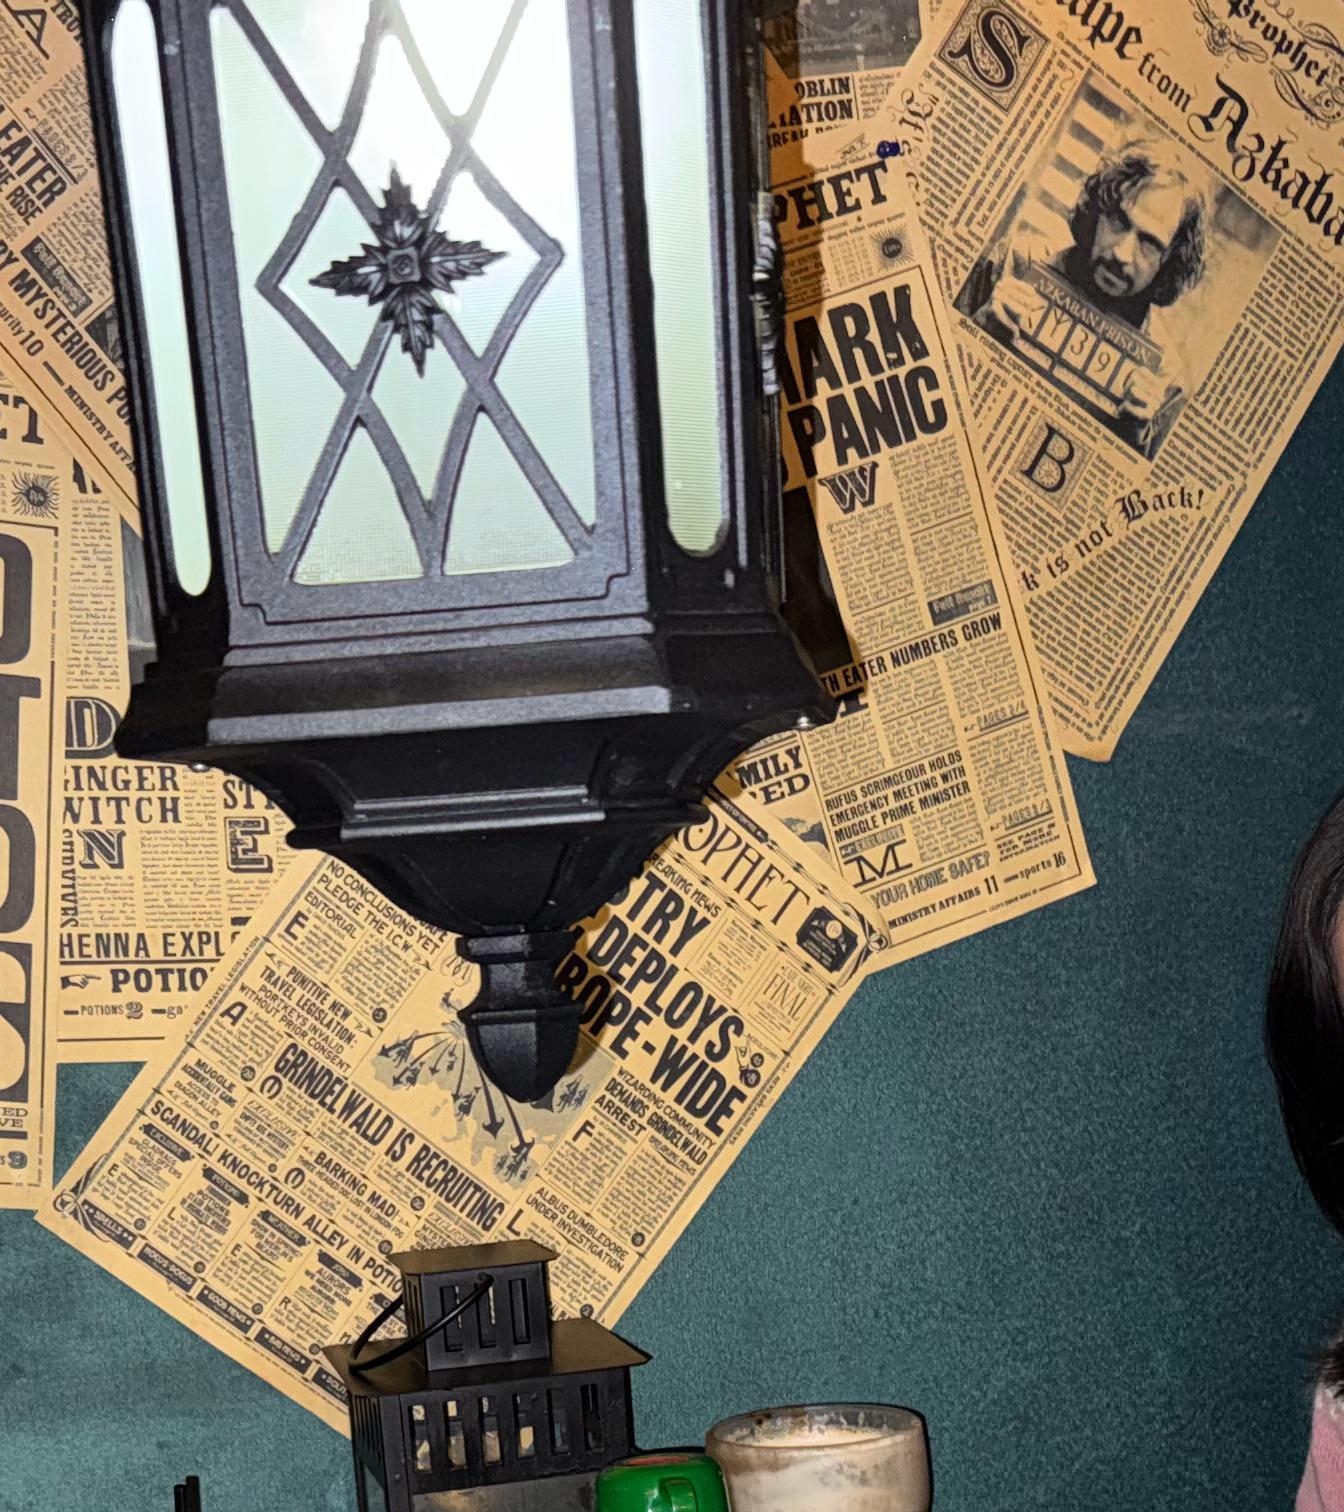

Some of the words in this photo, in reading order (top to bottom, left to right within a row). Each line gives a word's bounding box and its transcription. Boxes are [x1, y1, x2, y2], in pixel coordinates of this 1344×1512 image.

[795, 76, 851, 100] OBLIN
[1138, 51, 1193, 114] from
[5, 184, 44, 226] RISE
[8, 267, 116, 392] MYSTERIOUS
[20, 324, 44, 357] 10
[777, 284, 931, 404] ARK
[1034, 277, 1102, 330] AZKABAN
[1100, 319, 1155, 362] PRISON
[788, 366, 949, 479] PANIC
[1047, 554, 1070, 579] is
[1075, 522, 1114, 558] not
[1115, 488, 1205, 531] Back!
[842, 649, 888, 688] EATER
[890, 631, 959, 674] NUMBERS
[962, 612, 1002, 643] GROW
[826, 788, 859, 813] RUFUS
[860, 764, 928, 803] SCRIMGEOUR
[928, 750, 964, 777] HOLDS
[830, 797, 891, 828] EMERGENCY
[893, 780, 940, 808] MEETING
[941, 766, 967, 790] WITH
[834, 816, 879, 843] MUGGLE
[881, 802, 918, 827] PRIME
[919, 780, 972, 812] MINISTER
[937, 885, 981, 914] AFFAIRS
[984, 874, 1000, 897] 11
[1018, 857, 1053, 880] sports
[1052, 851, 1067, 869] 16
[305, 890, 358, 939] EDITORIAL
[317, 873, 364, 915] PLEDGE
[364, 910, 387, 934] THE
[327, 860, 346, 880] NO
[343, 873, 415, 936] CONCLUSIONS
[415, 930, 440, 955] YET
[690, 888, 722, 918] NEWS
[60, 932, 151, 959] HENNA
[81, 1004, 124, 1017] POTIONS
[259, 965, 294, 999] TRAVEL
[286, 966, 332, 1003] PUNITIVE
[328, 997, 353, 1021] NEW
[587, 915, 745, 1063] DEPLOYS
[239, 982, 281, 1020] WITHOUT
[278, 1012, 308, 1041] PRIOR
[307, 1035, 353, 1075] CONSENT
[257, 984, 313, 1029] PORTKEYS
[307, 1021, 345, 1055] INVALID
[273, 1042, 394, 1146] GRINDELWALD
[384, 1127, 416, 1163] IS
[405, 1143, 505, 1232] RECRUITING
[595, 1095, 647, 1137] ARREST
[605, 1078, 649, 1118] DEMANDS
[647, 1112, 708, 1166] GRINDELWALD
[617, 1067, 665, 1110] WIZARDING
[662, 1104, 717, 1149] COMMUNITY
[150, 1099, 219, 1158] SCANDAL!
[216, 1147, 306, 1221] KNOCKTURN
[303, 1214, 350, 1251] ALLEY
[347, 1245, 366, 1264] IN
[365, 1256, 404, 1295] POTIO
[313, 1150, 368, 1198] BARKING
[526, 1194, 559, 1224] UNDER
[556, 1219, 625, 1273] INVESTIGATION
[536, 1187, 569, 1215] ALBUS
[567, 1209, 629, 1260] DUMBLEDORE
